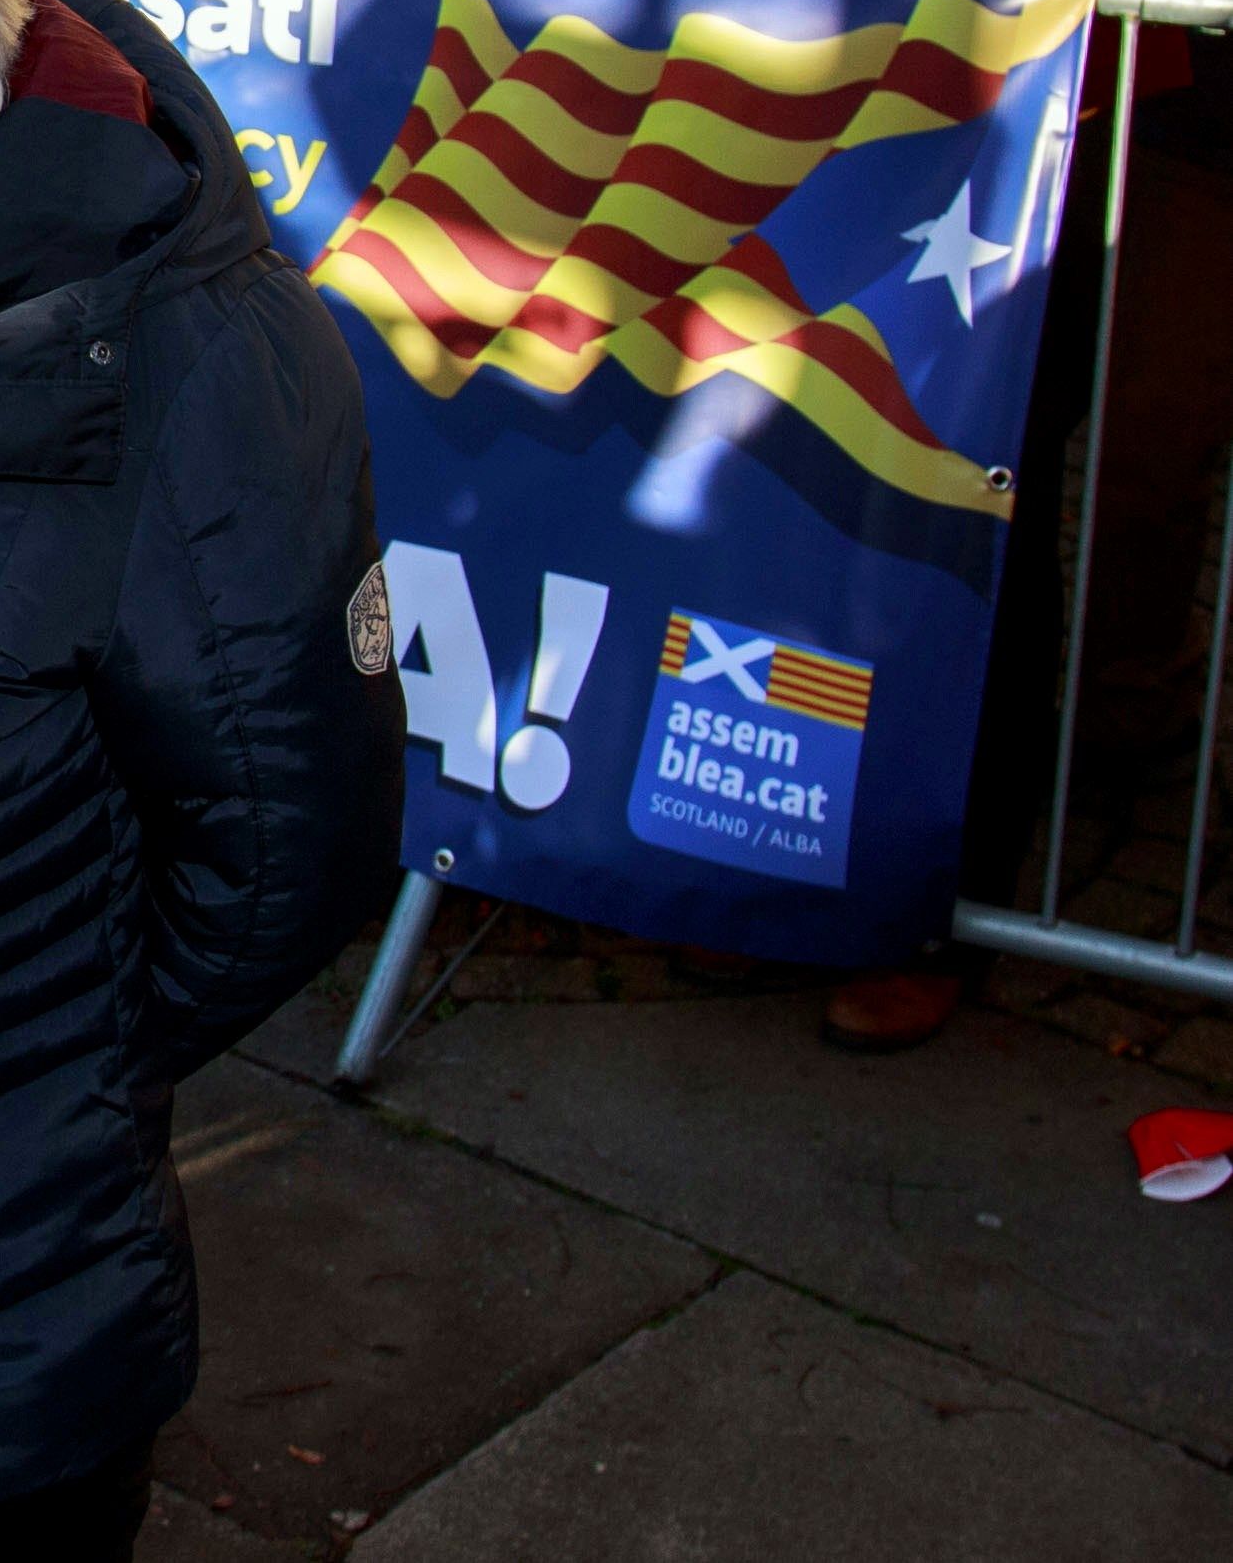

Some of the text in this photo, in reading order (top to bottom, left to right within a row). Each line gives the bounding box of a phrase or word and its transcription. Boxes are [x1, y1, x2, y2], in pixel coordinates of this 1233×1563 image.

[666, 700, 800, 767] assem
[657, 734, 829, 824] blea.cat
[648, 792, 750, 839] SCOTLAND
[768, 828, 824, 858] ALBA
